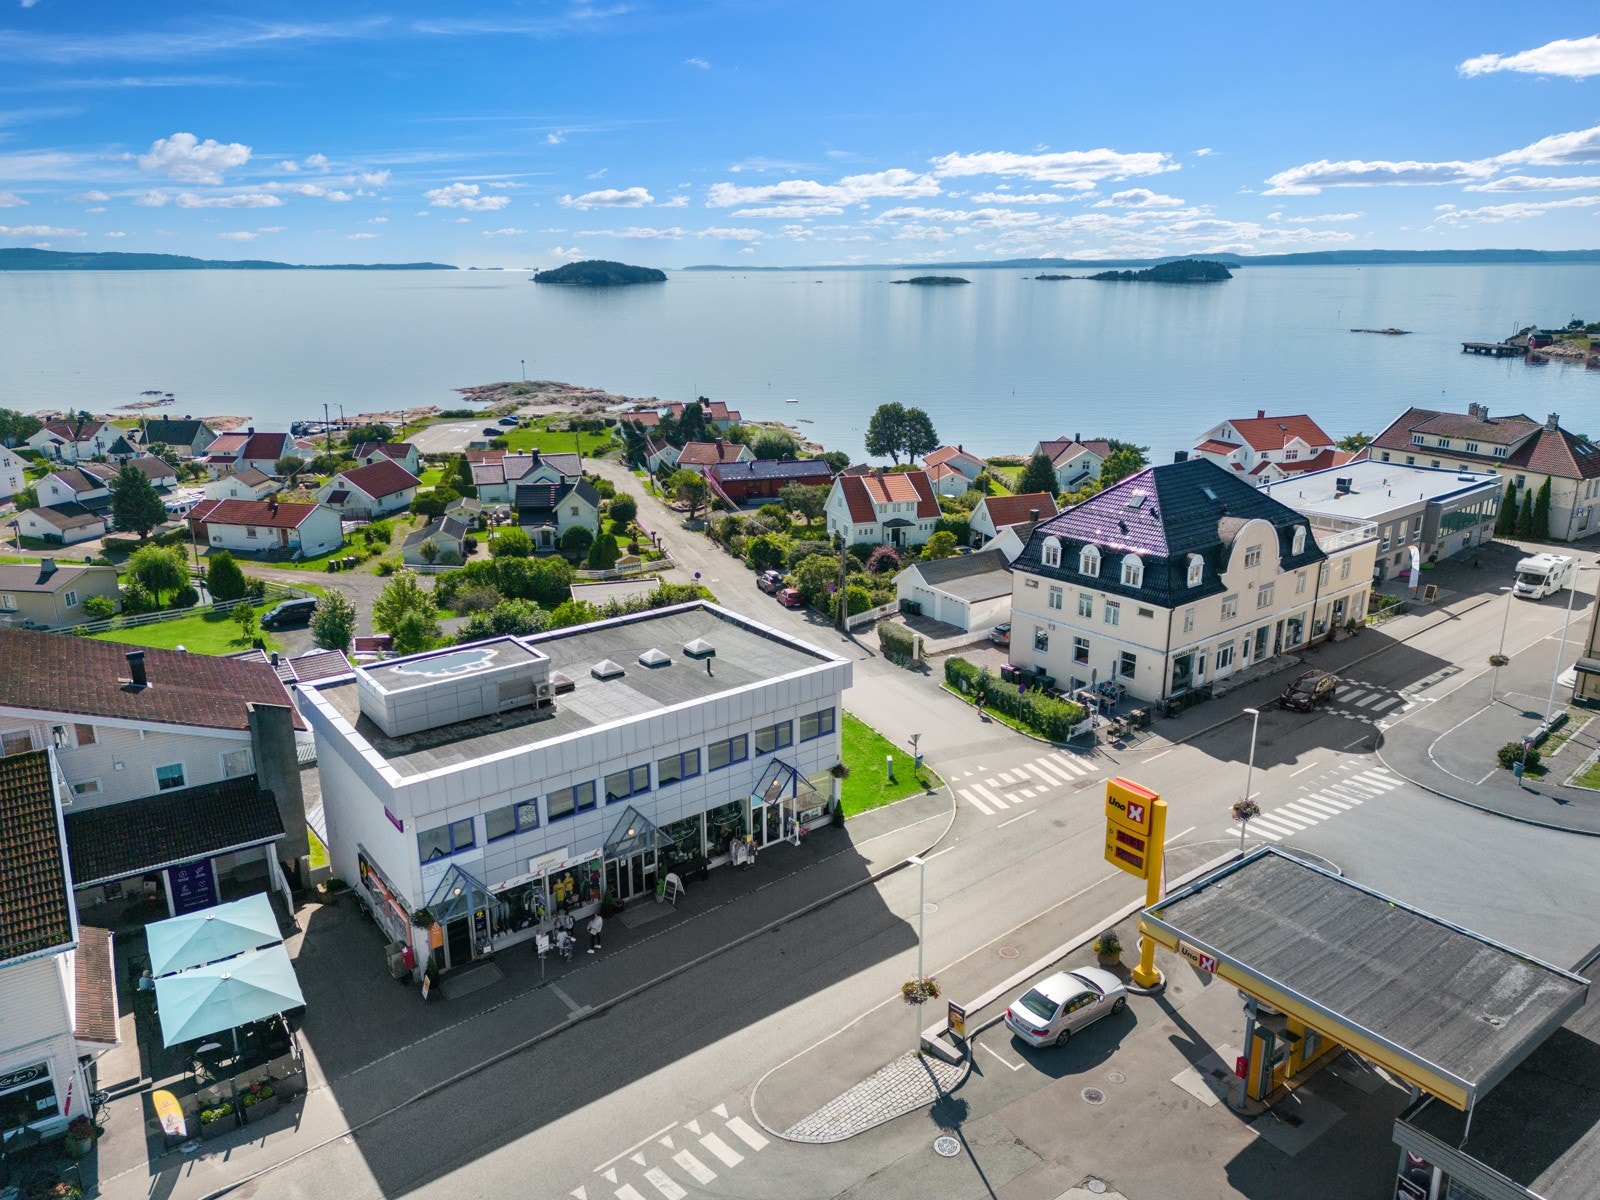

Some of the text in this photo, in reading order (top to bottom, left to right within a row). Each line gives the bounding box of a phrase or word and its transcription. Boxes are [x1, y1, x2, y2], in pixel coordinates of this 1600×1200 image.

[1108, 796, 1143, 822] Uno X
[1181, 947, 1214, 972] Uno X
